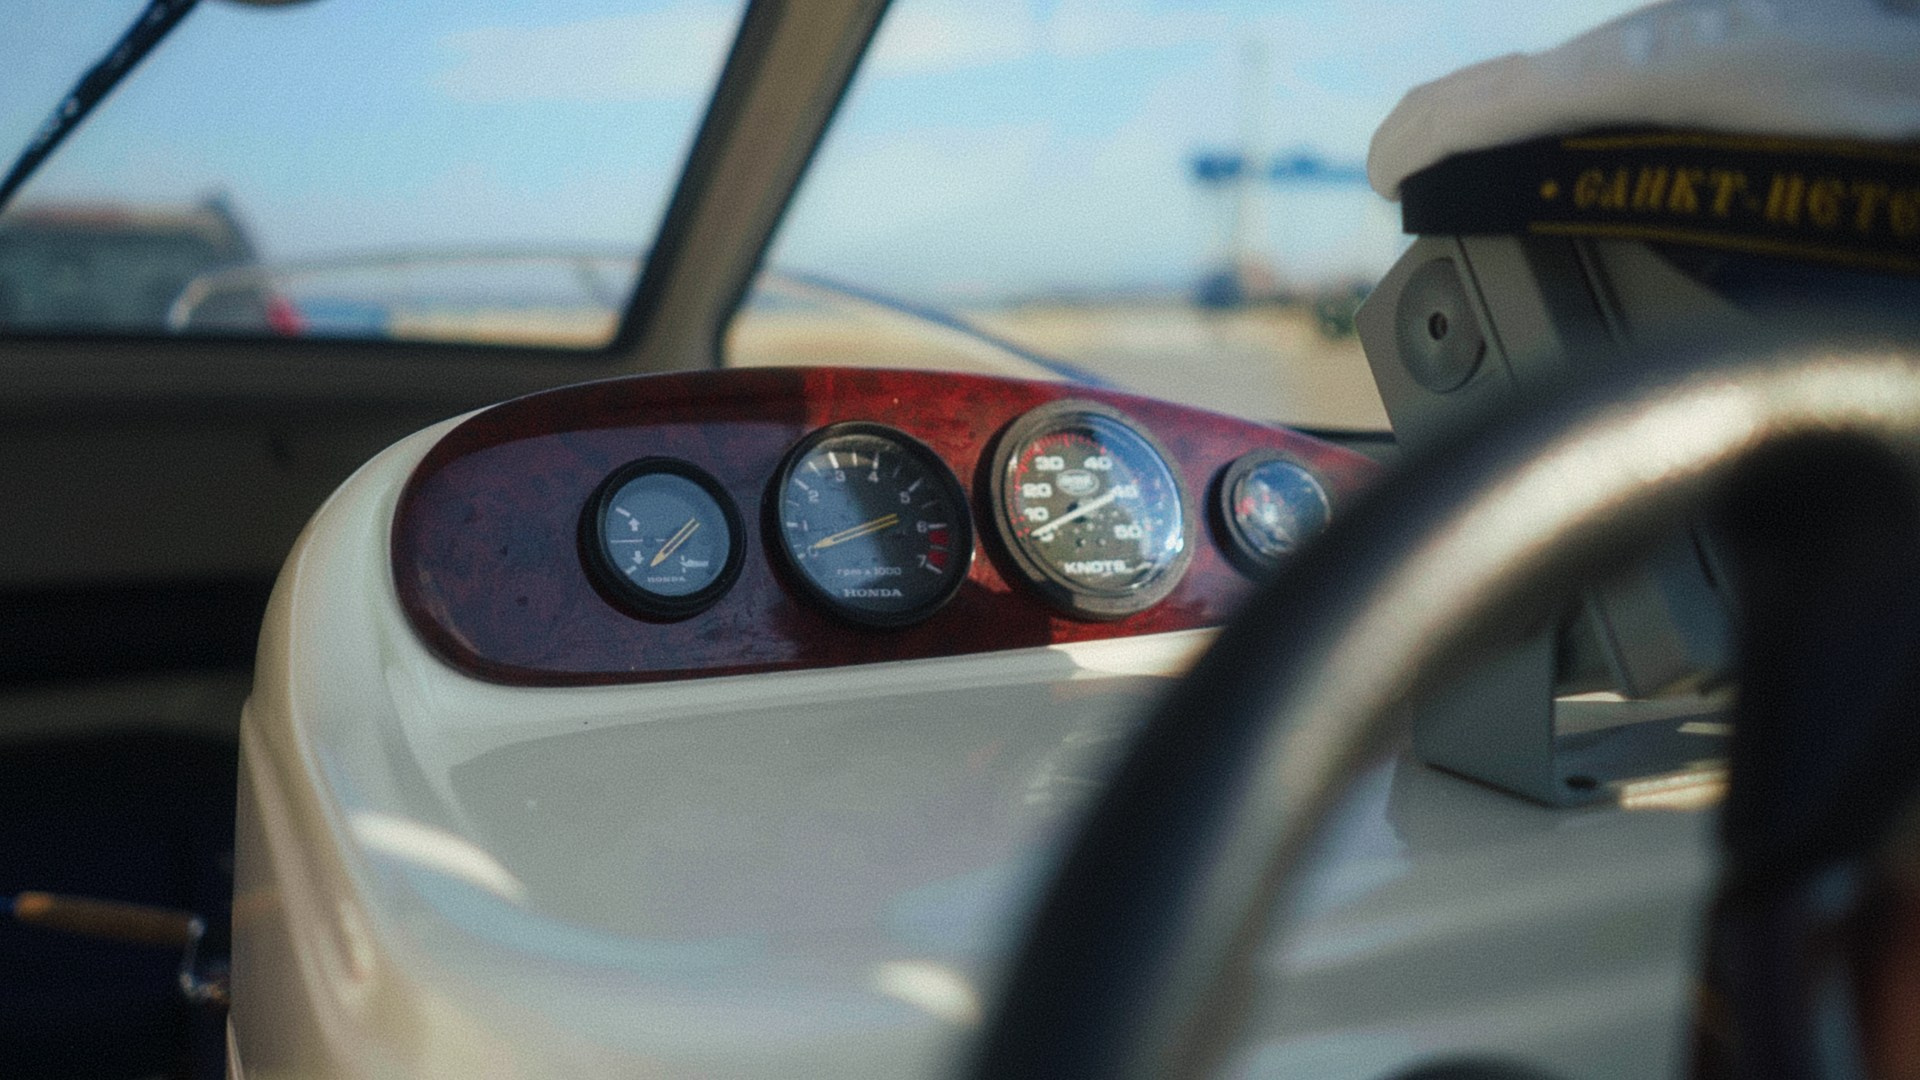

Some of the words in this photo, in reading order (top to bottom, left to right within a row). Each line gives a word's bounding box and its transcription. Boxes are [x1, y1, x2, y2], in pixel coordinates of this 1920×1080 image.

[1035, 456, 1065, 471] 30
[1083, 456, 1112, 471] 40
[835, 470, 846, 482] 3
[868, 471, 879, 483] 4
[808, 490, 820, 502] 2
[1022, 483, 1052, 498] 20
[900, 491, 911, 503] 5
[1024, 507, 1049, 522] 10
[802, 520, 809, 531] 1
[916, 521, 927, 533] 6
[917, 555, 928, 568] 7
[1064, 560, 1126, 574] KNOTS
[836, 568, 862, 577] rpm
[874, 566, 902, 576] 1000
[844, 588, 903, 598] HONDA
